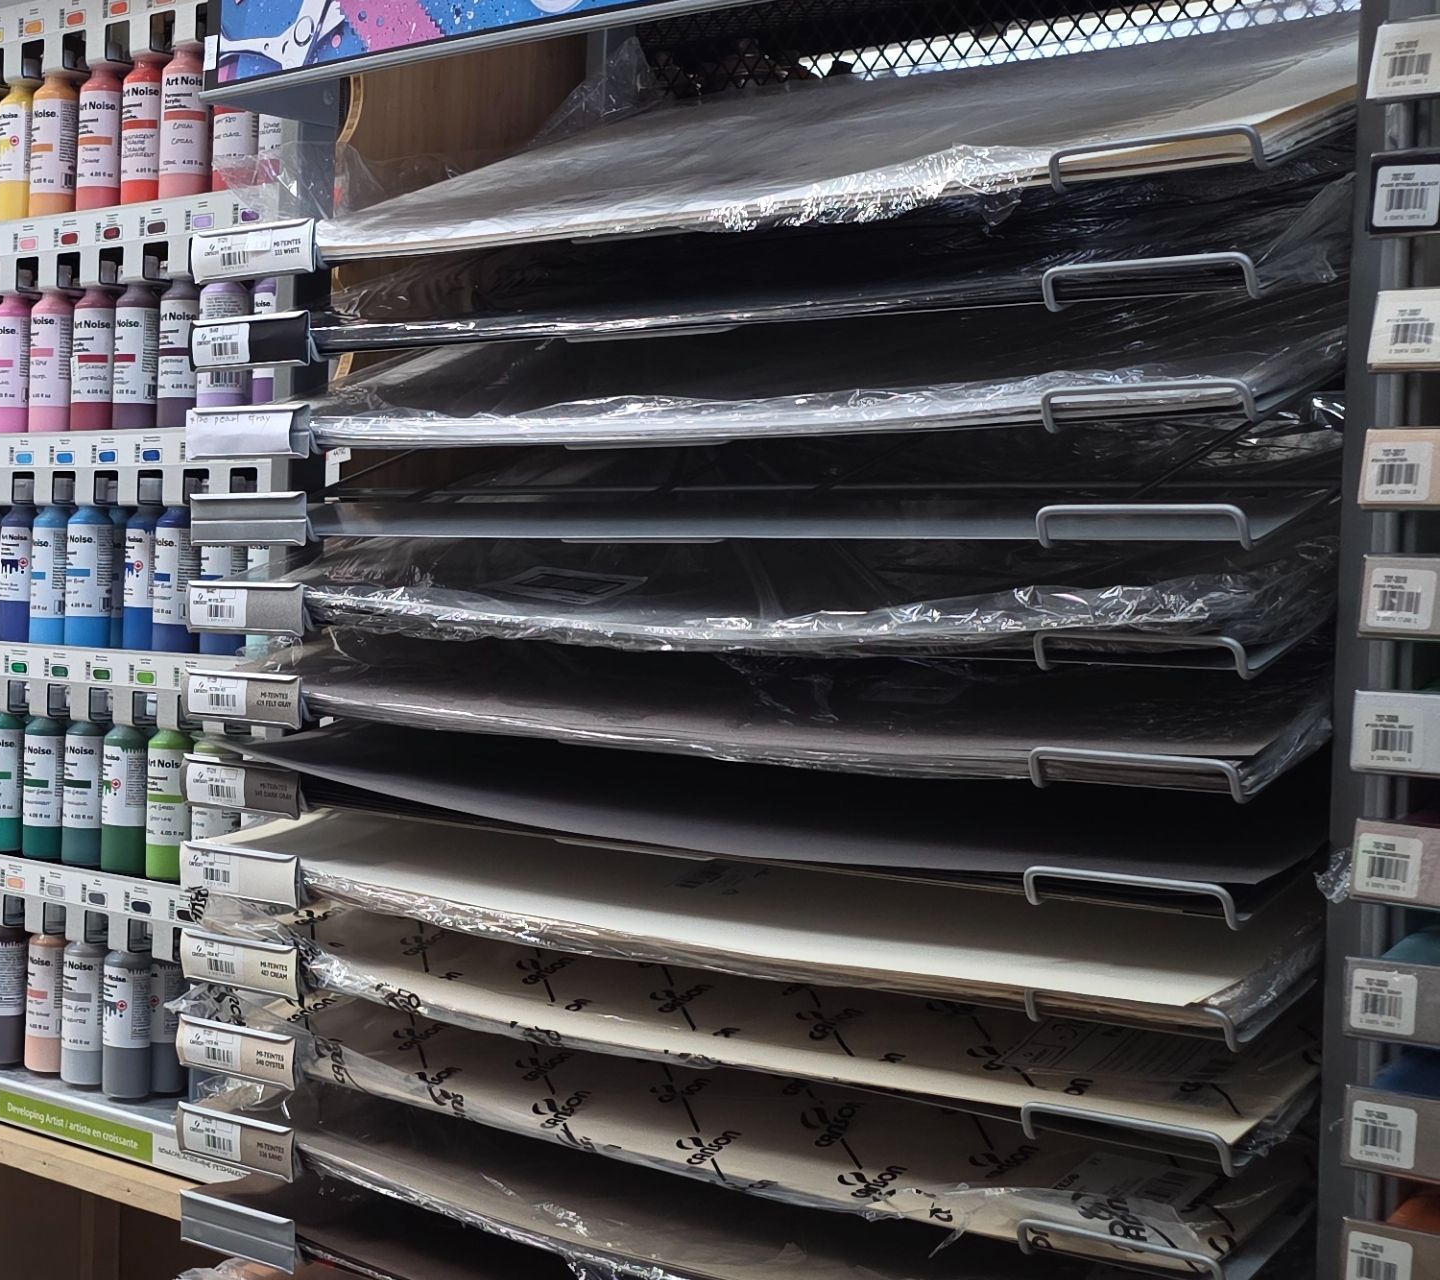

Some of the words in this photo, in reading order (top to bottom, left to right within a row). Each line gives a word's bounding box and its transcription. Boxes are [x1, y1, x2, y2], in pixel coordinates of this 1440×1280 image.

[166, 77, 179, 86] Art
[181, 76, 203, 86] Nois
[270, 970, 288, 980] CREAM
[7, 1102, 45, 1124] Developing
[46, 1113, 64, 1129] Artist
[69, 1120, 90, 1136] artiste
[92, 1126, 102, 1137] en
[102, 1129, 138, 1150] croissante
